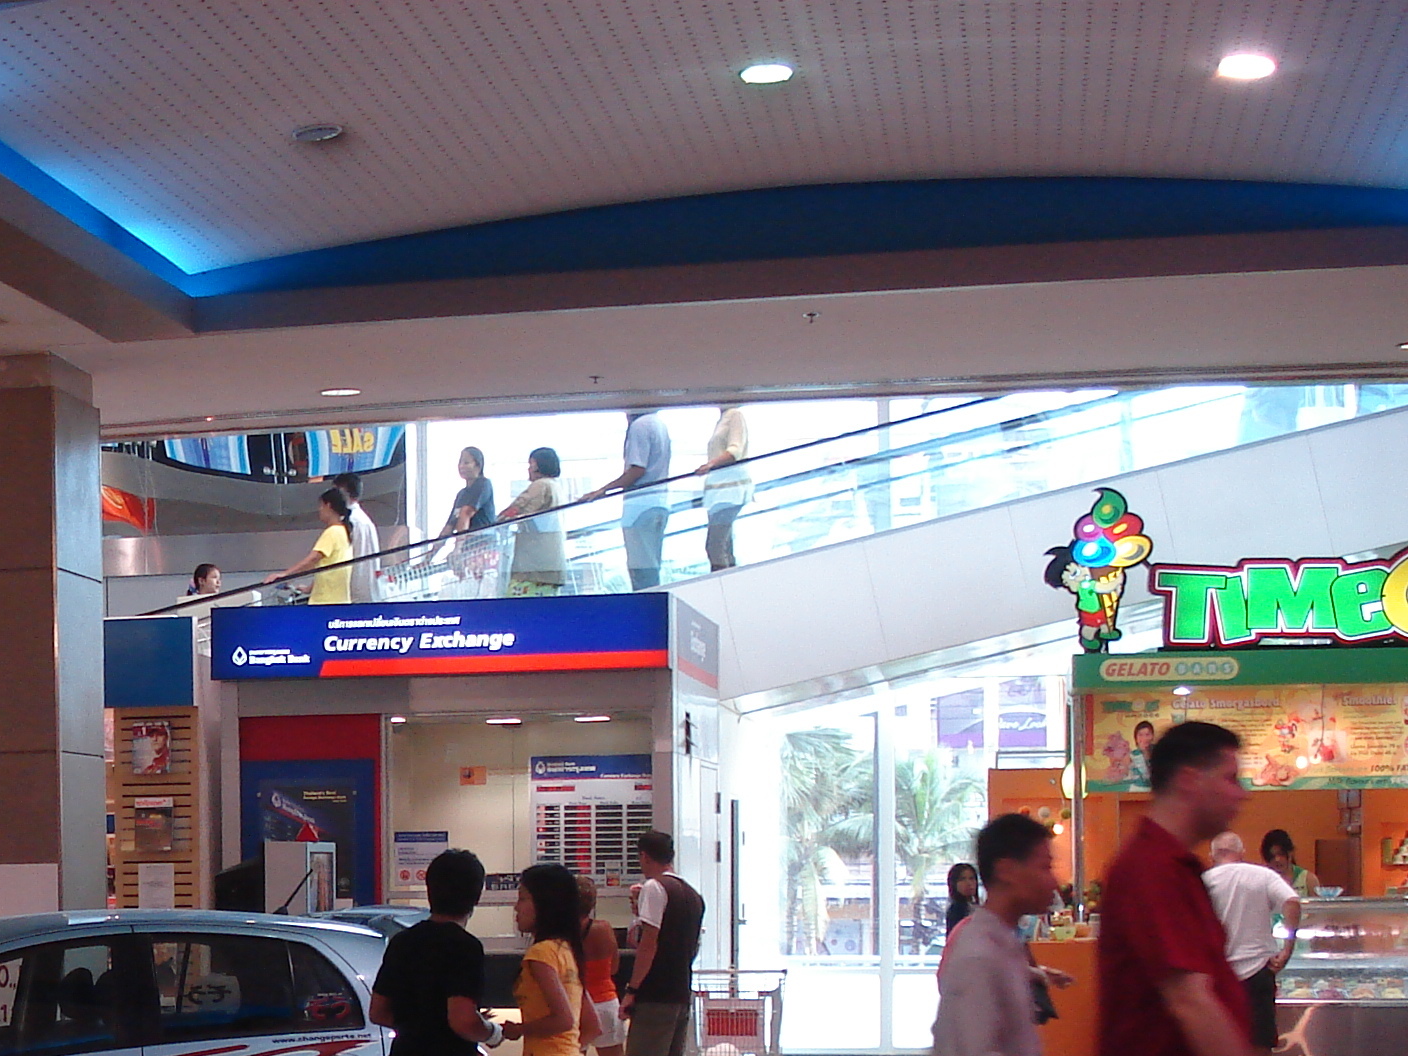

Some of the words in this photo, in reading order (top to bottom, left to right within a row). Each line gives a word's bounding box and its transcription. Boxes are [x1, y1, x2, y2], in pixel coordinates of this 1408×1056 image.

[323, 635, 414, 653] Currency
[419, 631, 514, 650] Exchange
[1105, 662, 1171, 677] GELATO
[1177, 661, 1233, 676] BARS
